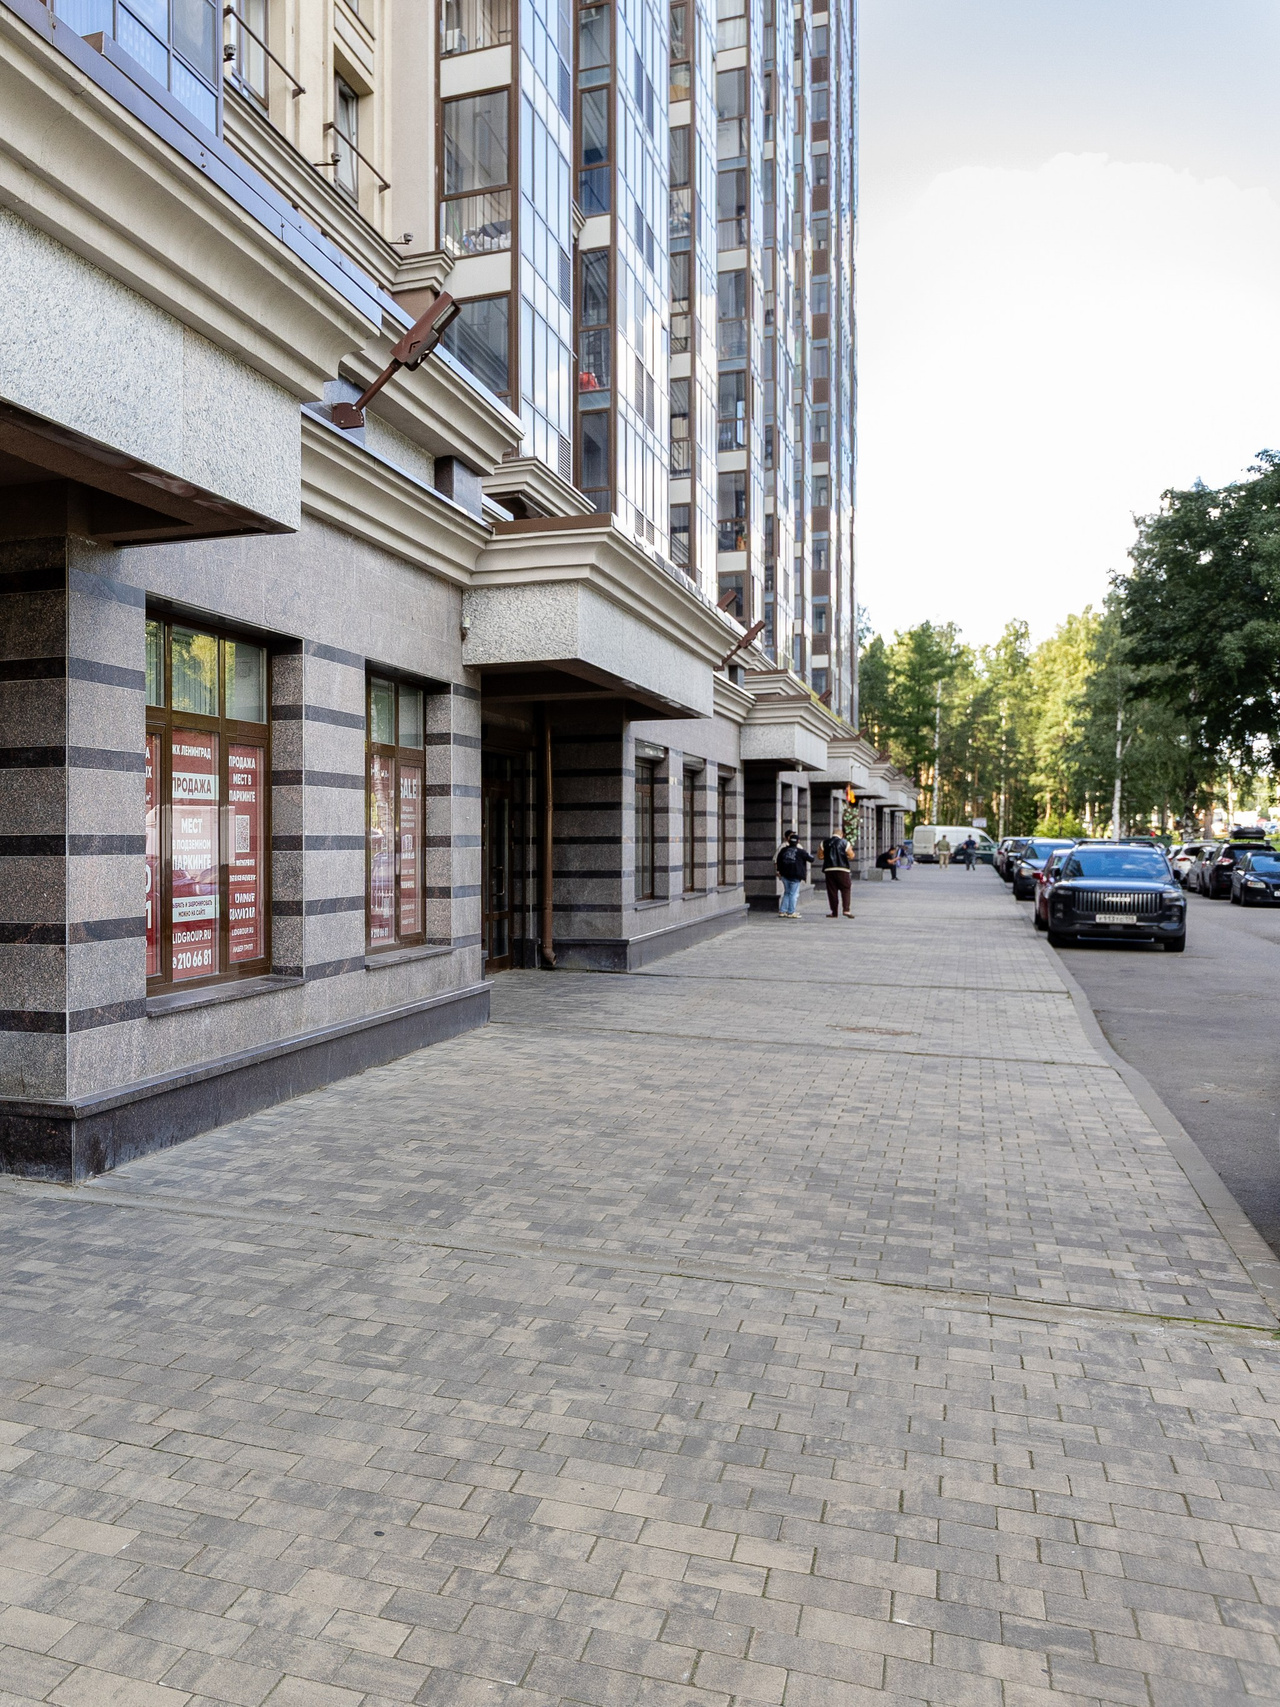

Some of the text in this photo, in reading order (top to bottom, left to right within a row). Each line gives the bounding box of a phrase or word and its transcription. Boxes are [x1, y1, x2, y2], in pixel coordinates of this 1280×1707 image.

[181, 745, 211, 760] ЛЕНИНГРАД
[228, 756, 256, 770] ПРОДАЖА
[172, 776, 211, 796] ПРОДАЖА
[232, 773, 252, 785] МЕСТ В
[228, 790, 256, 803] ПАРКИНГЕ
[181, 818, 203, 834] МЕСТ
[176, 839, 211, 851] ПОДЗЕМНОМ
[172, 853, 211, 870] ПАРКИНГЕ
[172, 928, 212, 944] LIDGROUP.RU
[177, 948, 212, 970] 210 66 81
